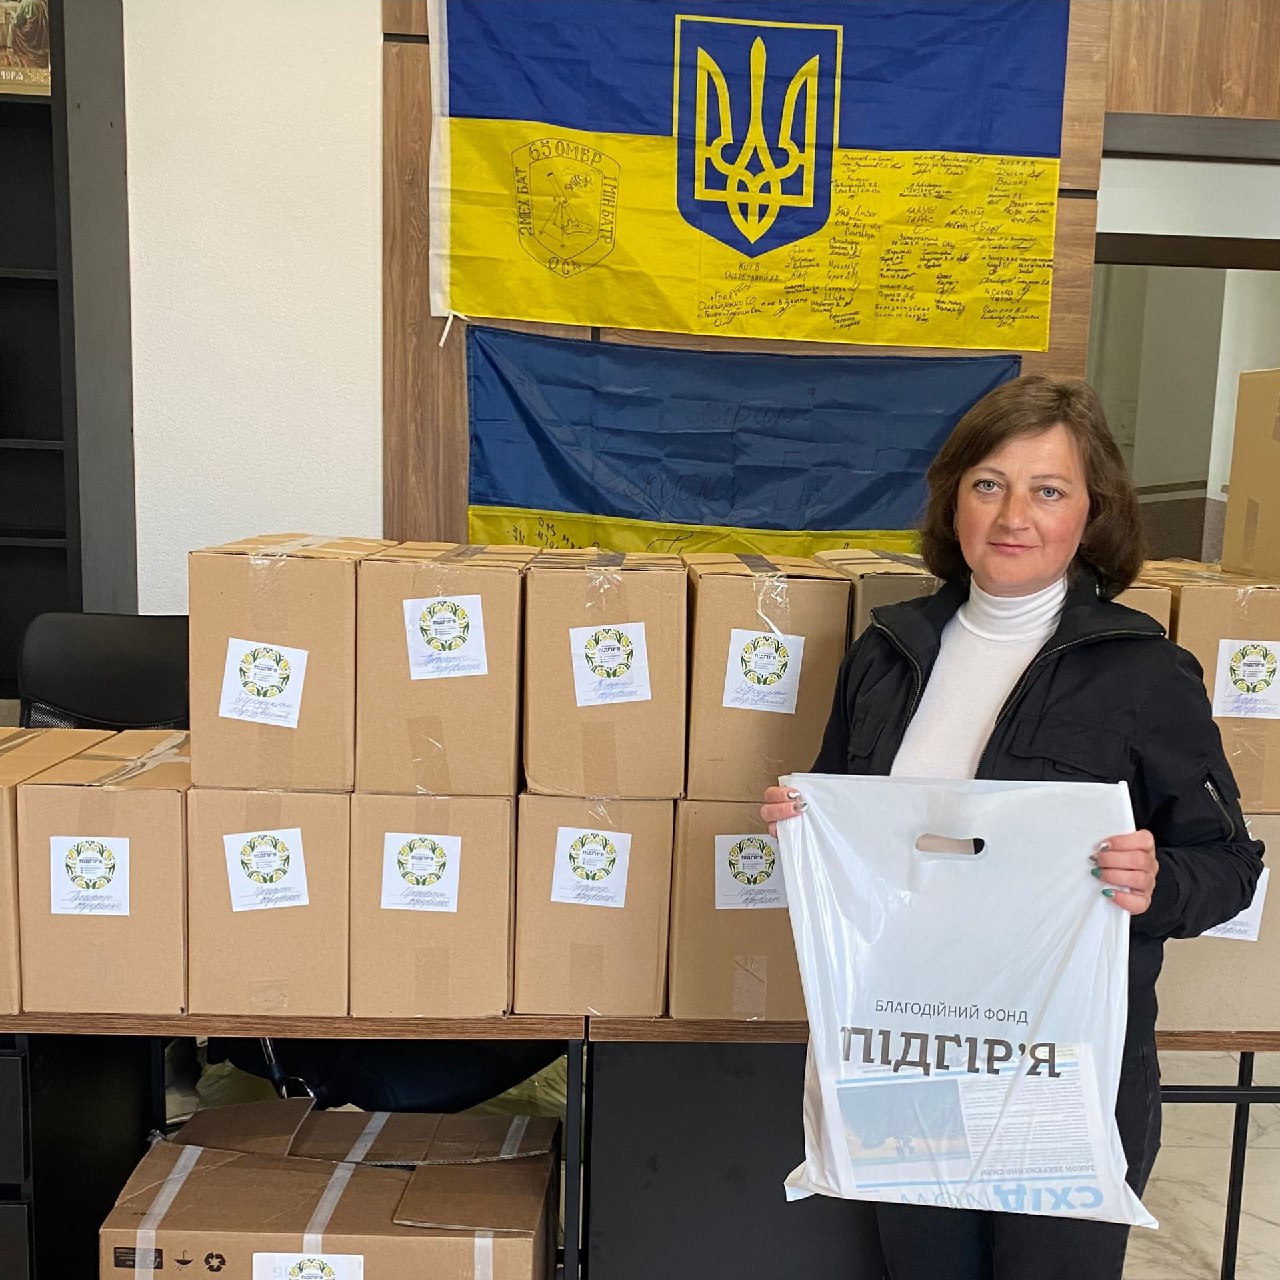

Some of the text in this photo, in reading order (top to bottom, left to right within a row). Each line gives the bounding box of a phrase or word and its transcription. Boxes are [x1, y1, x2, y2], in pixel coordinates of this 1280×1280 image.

[875, 999, 1028, 1025] БЛАГОДІЙНИЙ ФОНД
[840, 1027, 1061, 1078] ПІДГІР'Я
